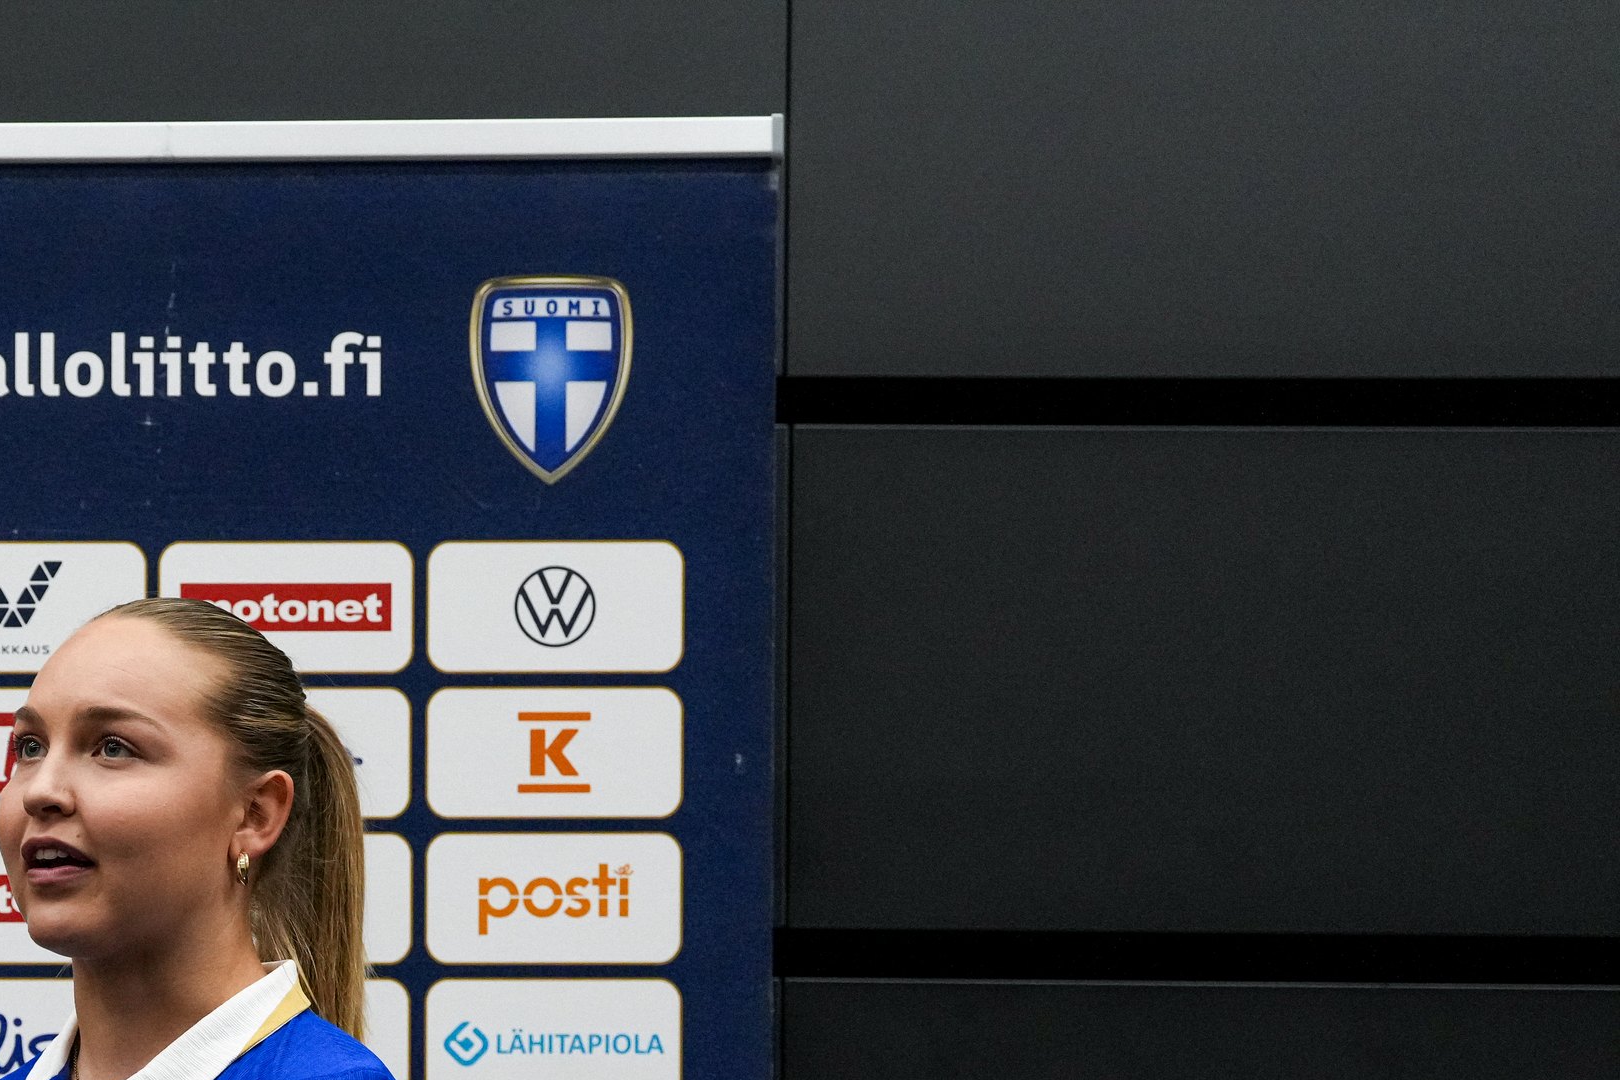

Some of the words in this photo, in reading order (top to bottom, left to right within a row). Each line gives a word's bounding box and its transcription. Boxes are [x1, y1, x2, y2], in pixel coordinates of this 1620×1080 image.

[503, 300, 600, 316] SUOMI
[529, 728, 580, 777] K
[478, 863, 633, 936] posti
[496, 1028, 664, 1055] LÄHITAPIOLA
